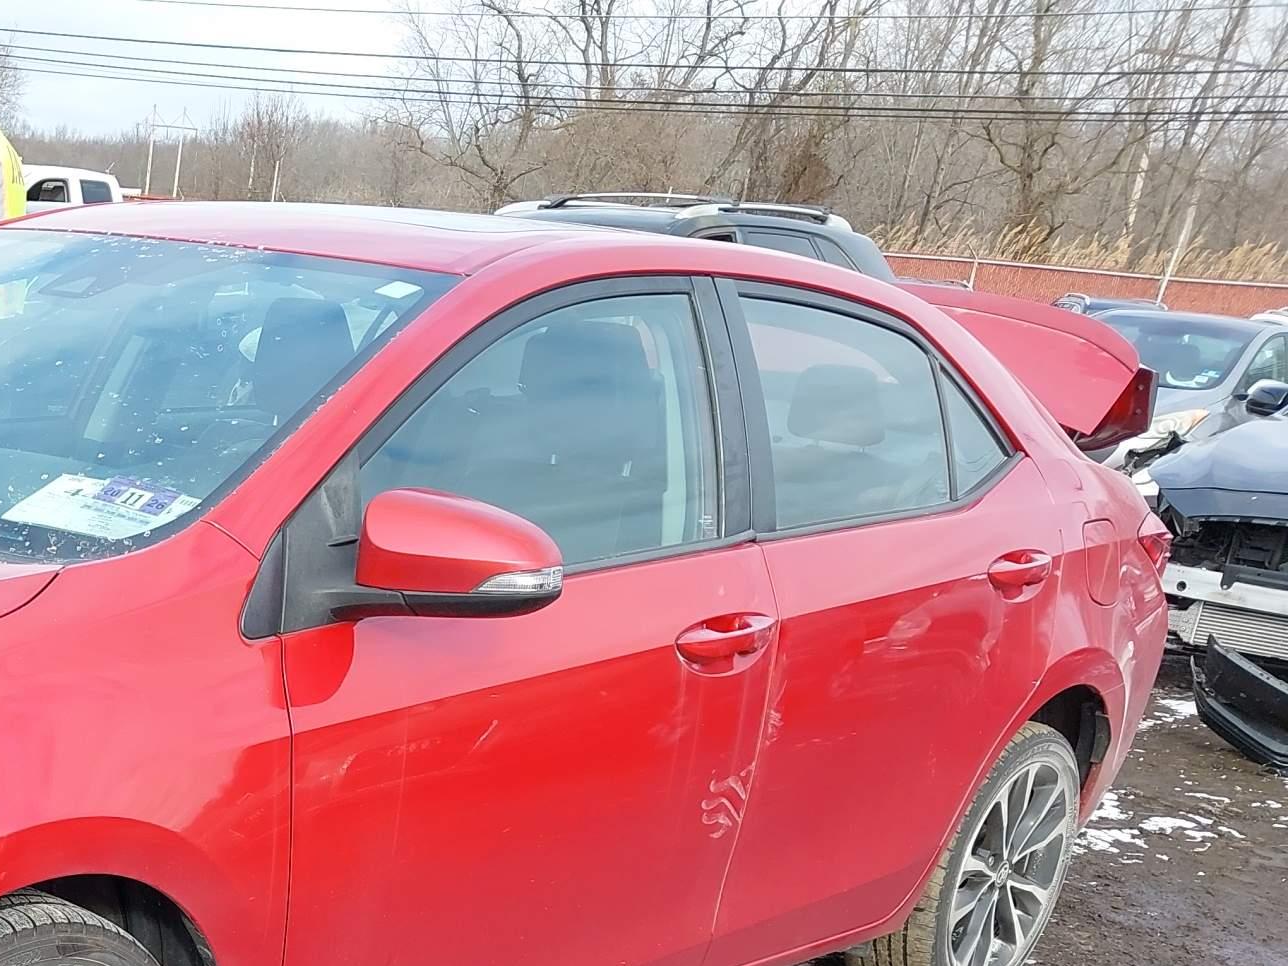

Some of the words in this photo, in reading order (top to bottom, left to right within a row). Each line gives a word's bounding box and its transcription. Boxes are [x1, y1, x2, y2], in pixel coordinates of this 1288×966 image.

[103, 487, 121, 497] 20
[120, 491, 145, 506] 11
[146, 499, 167, 510] 26
